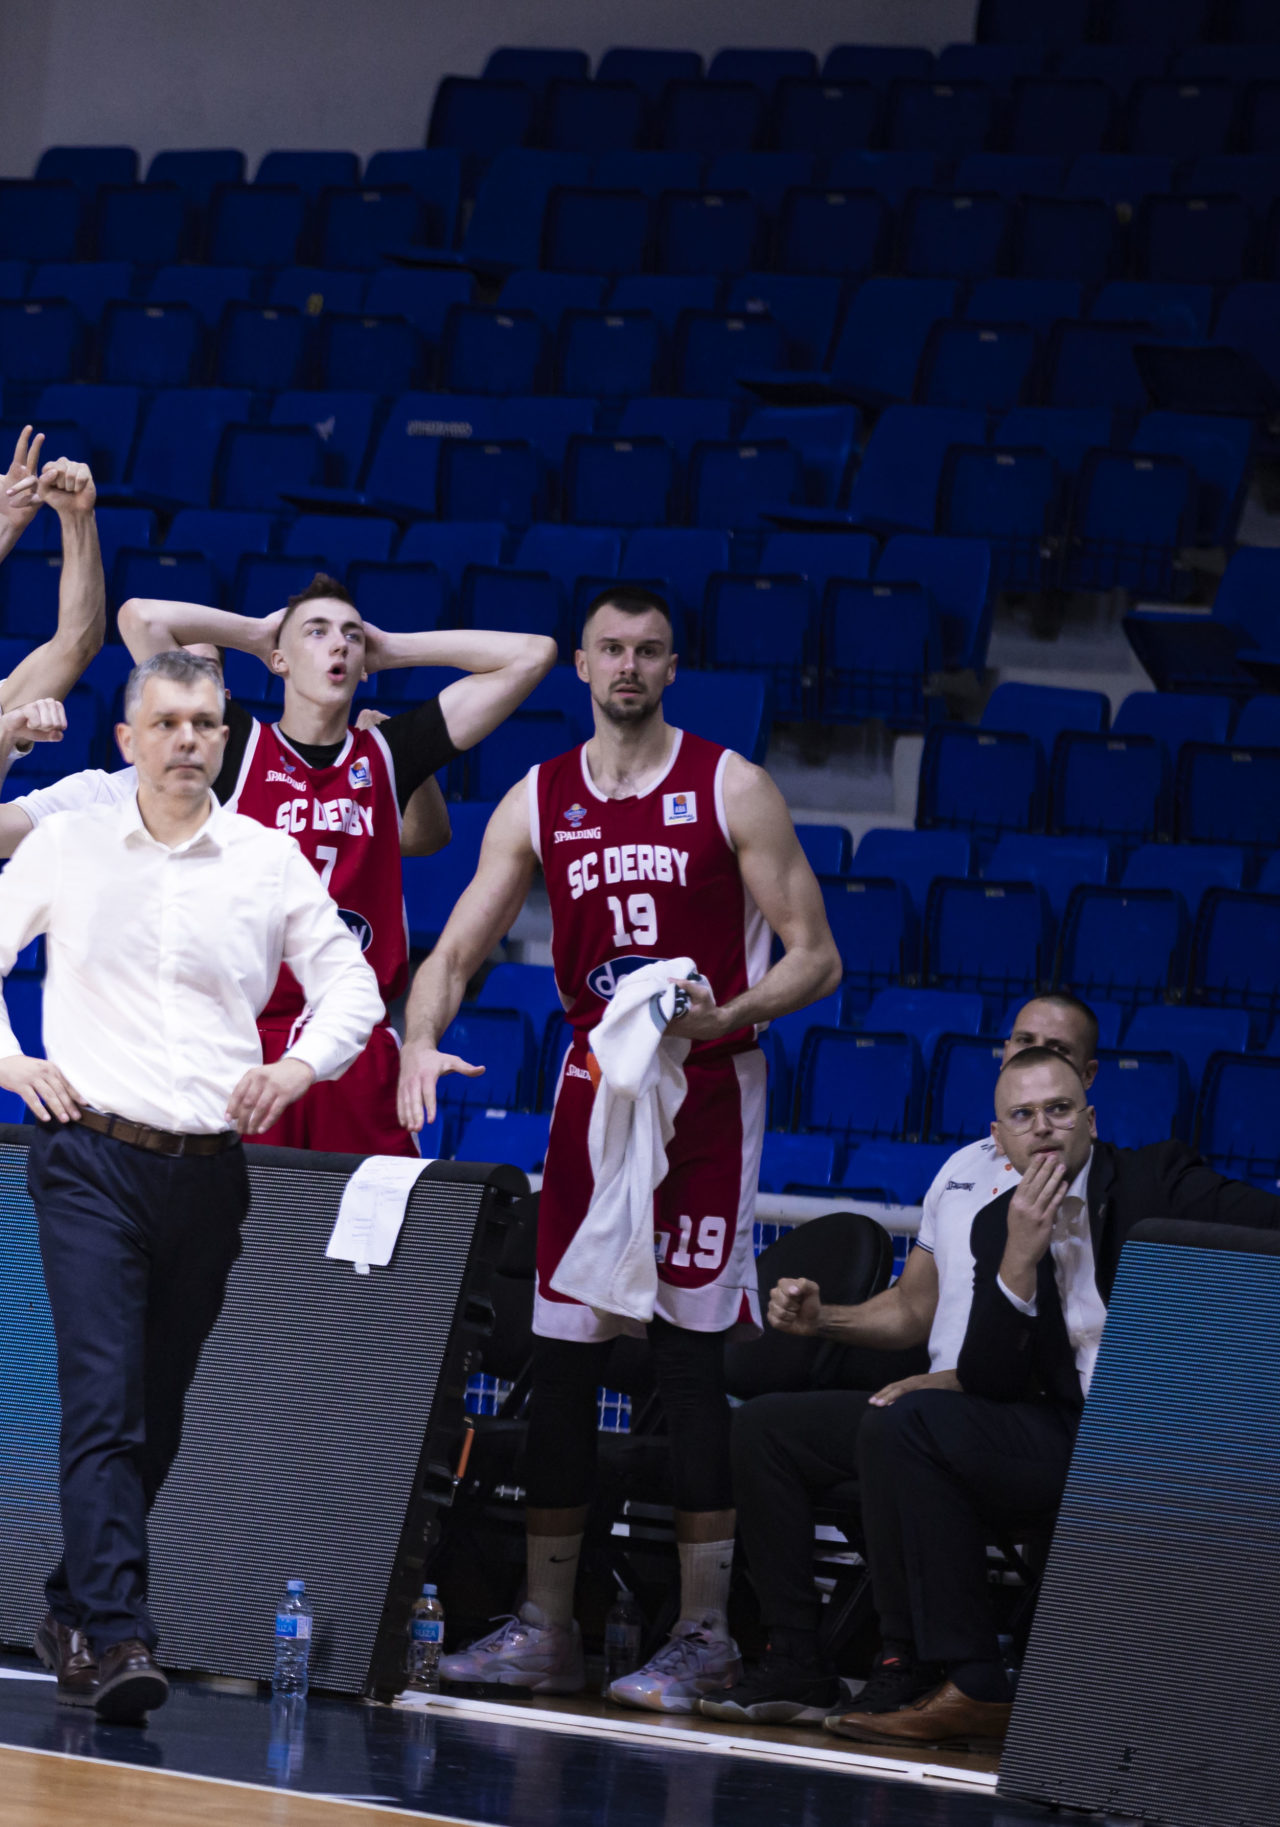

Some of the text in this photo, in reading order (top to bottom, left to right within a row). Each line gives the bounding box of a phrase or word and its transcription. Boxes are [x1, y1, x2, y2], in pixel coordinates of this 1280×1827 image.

[264, 769, 307, 792] SPALDING
[276, 798, 375, 837] SC DERBY
[554, 826, 602, 844] SPALDING
[568, 844, 689, 900] SC DERBY
[607, 893, 658, 947] 19
[671, 1215, 727, 1269] 19
